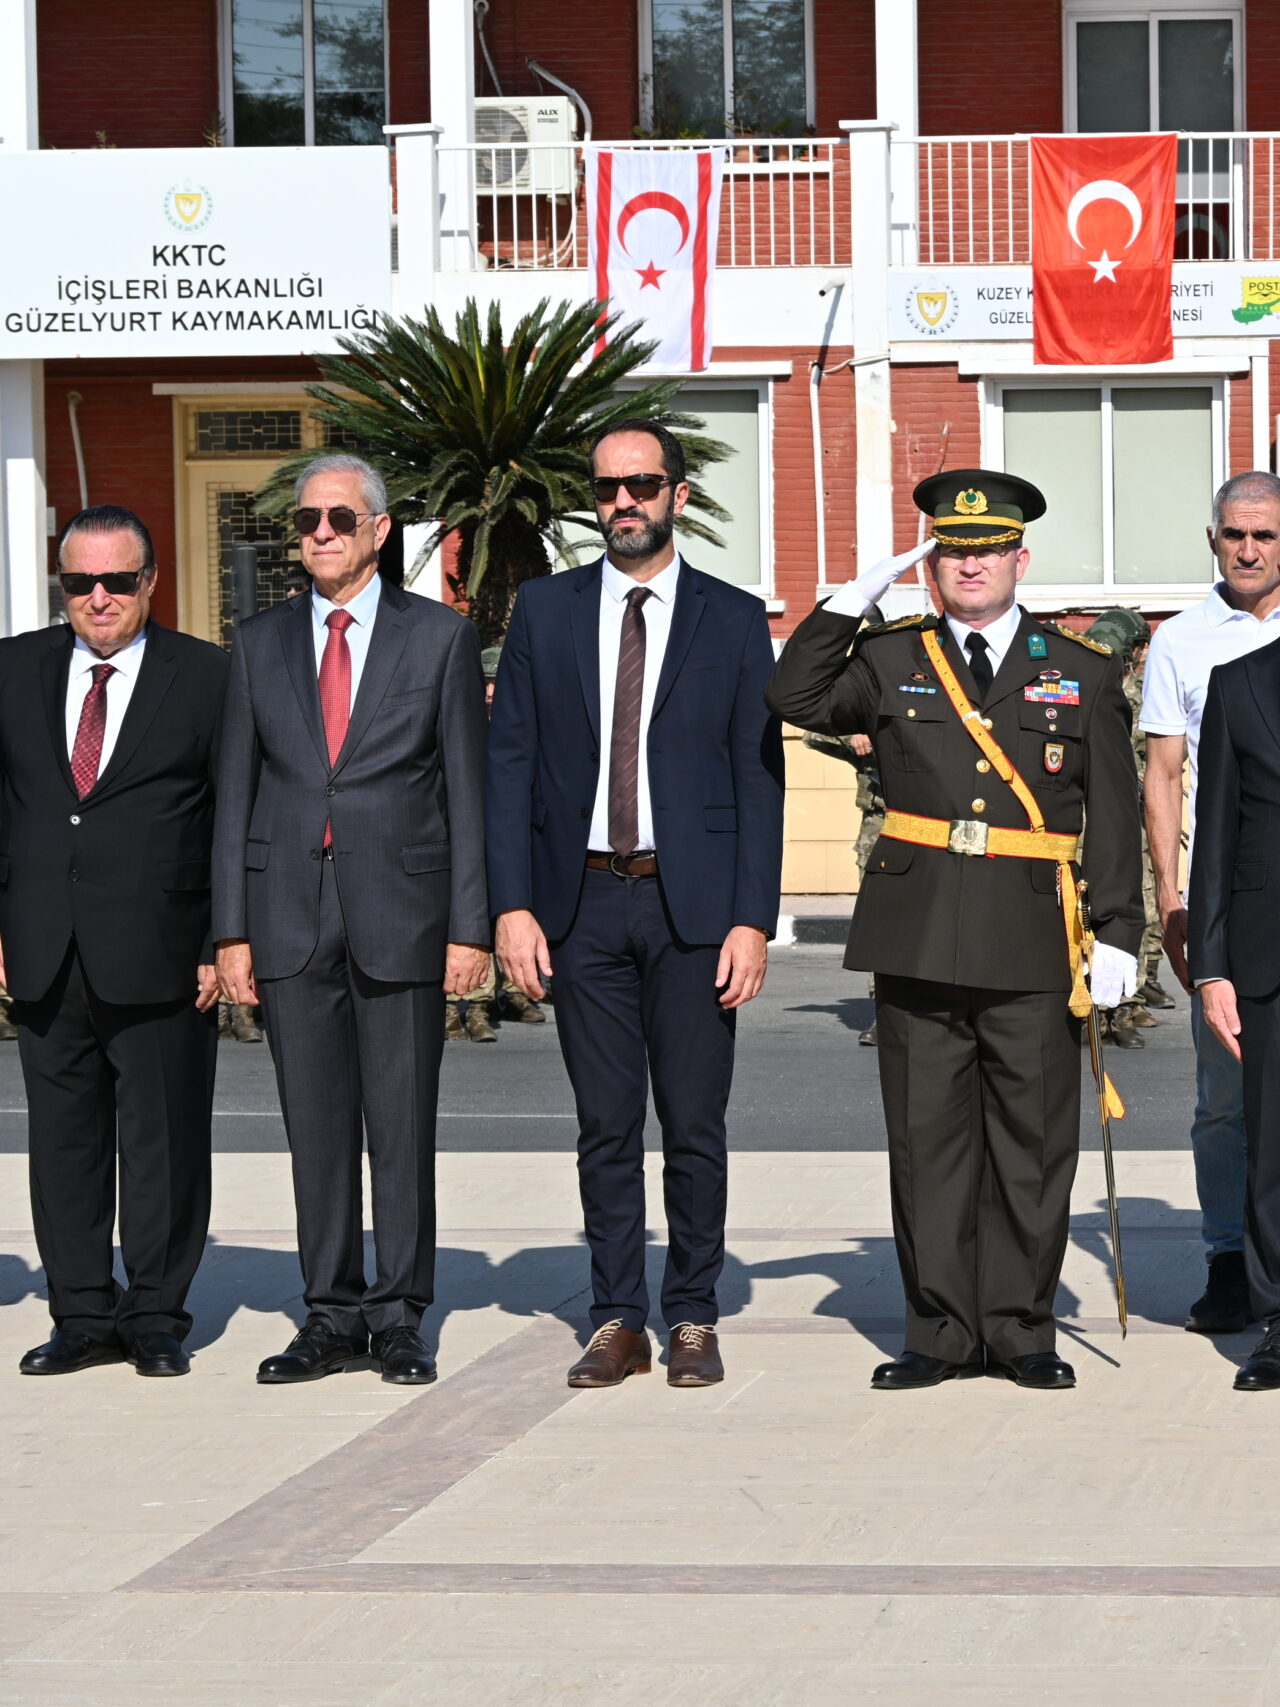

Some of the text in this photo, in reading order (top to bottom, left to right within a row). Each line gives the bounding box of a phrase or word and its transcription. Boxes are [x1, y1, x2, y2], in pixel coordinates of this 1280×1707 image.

[152, 244, 226, 267] KKTC
[58, 272, 323, 305] İÇİŞLERİ BAKANLIĞI
[977, 286, 1022, 300] KUZEY
[1171, 280, 1214, 297] RİYETİ
[5, 308, 163, 333] GÜZELYURT
[989, 308, 1033, 325] GÜZEL
[1172, 305, 1202, 322] NESİ
